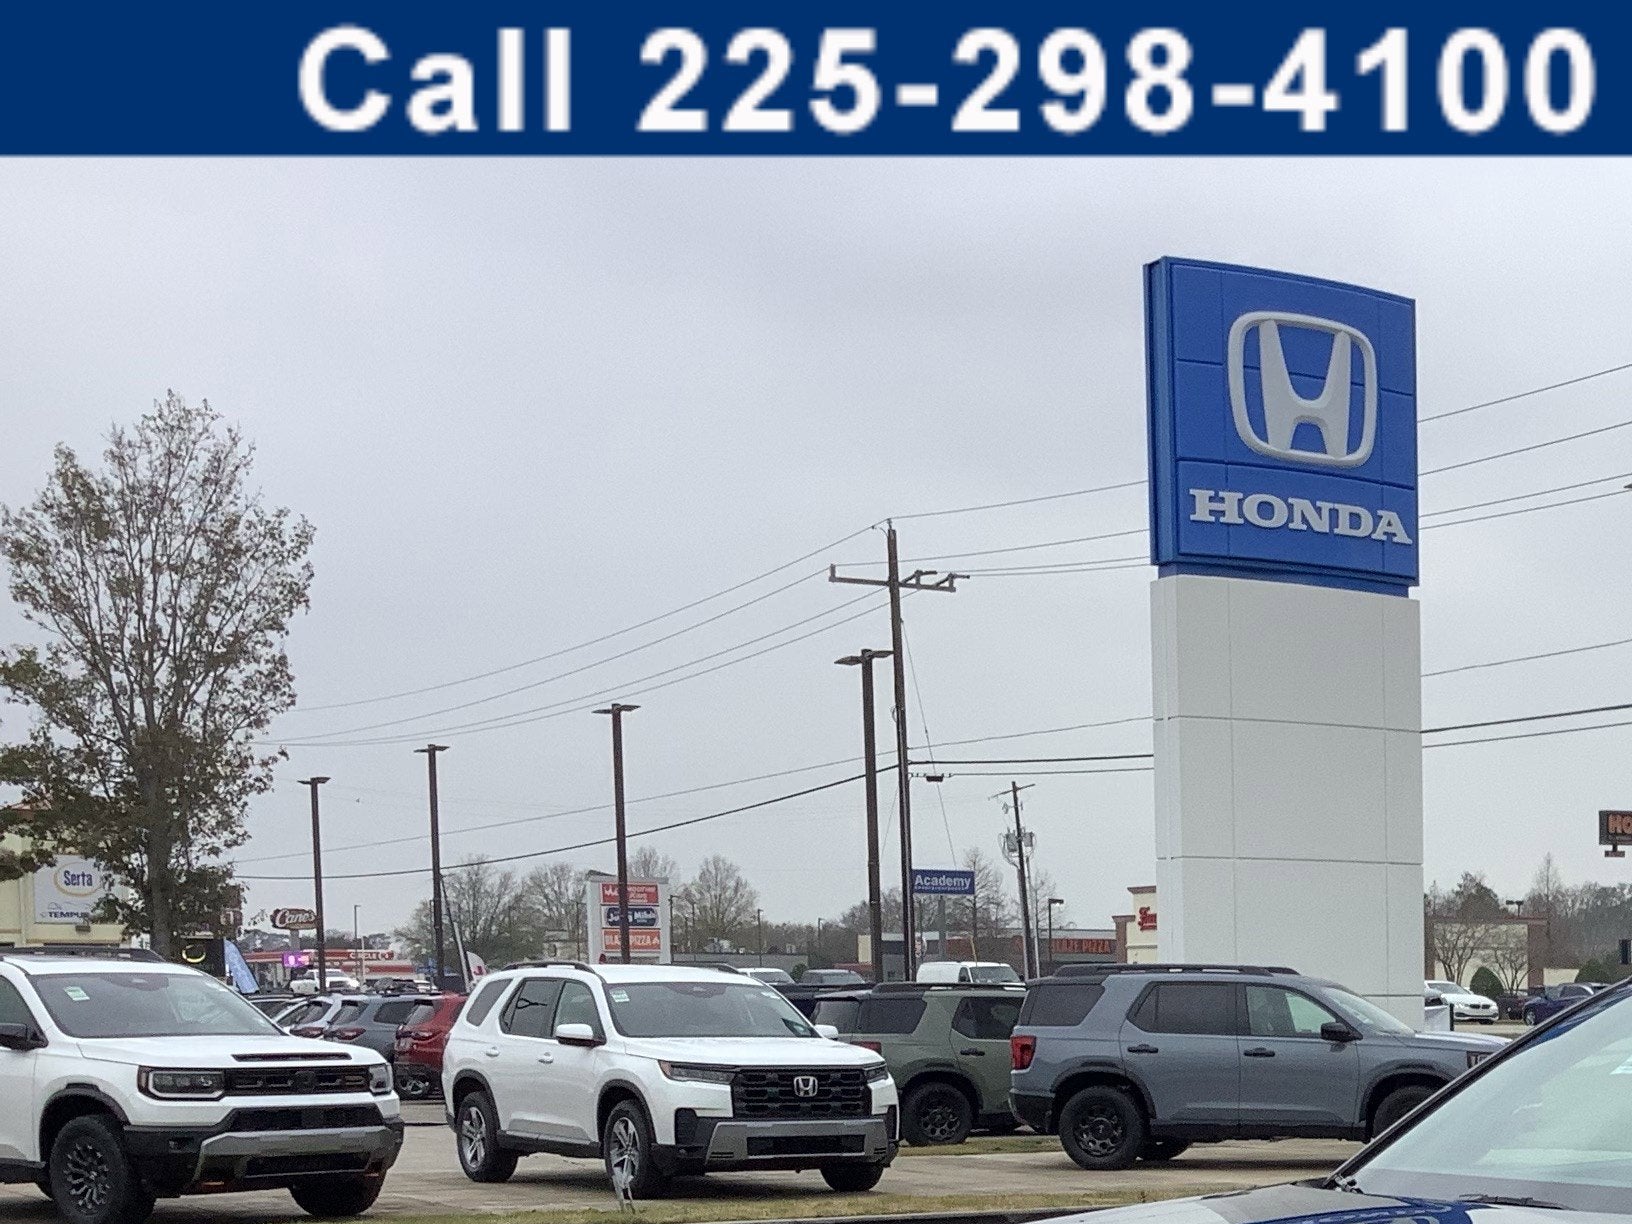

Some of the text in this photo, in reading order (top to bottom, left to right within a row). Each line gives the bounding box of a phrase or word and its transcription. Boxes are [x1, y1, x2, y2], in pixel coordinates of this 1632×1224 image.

[1189, 488, 1413, 545] HONDA
[64, 870, 93, 886] Serta
[914, 874, 971, 889] Academy
